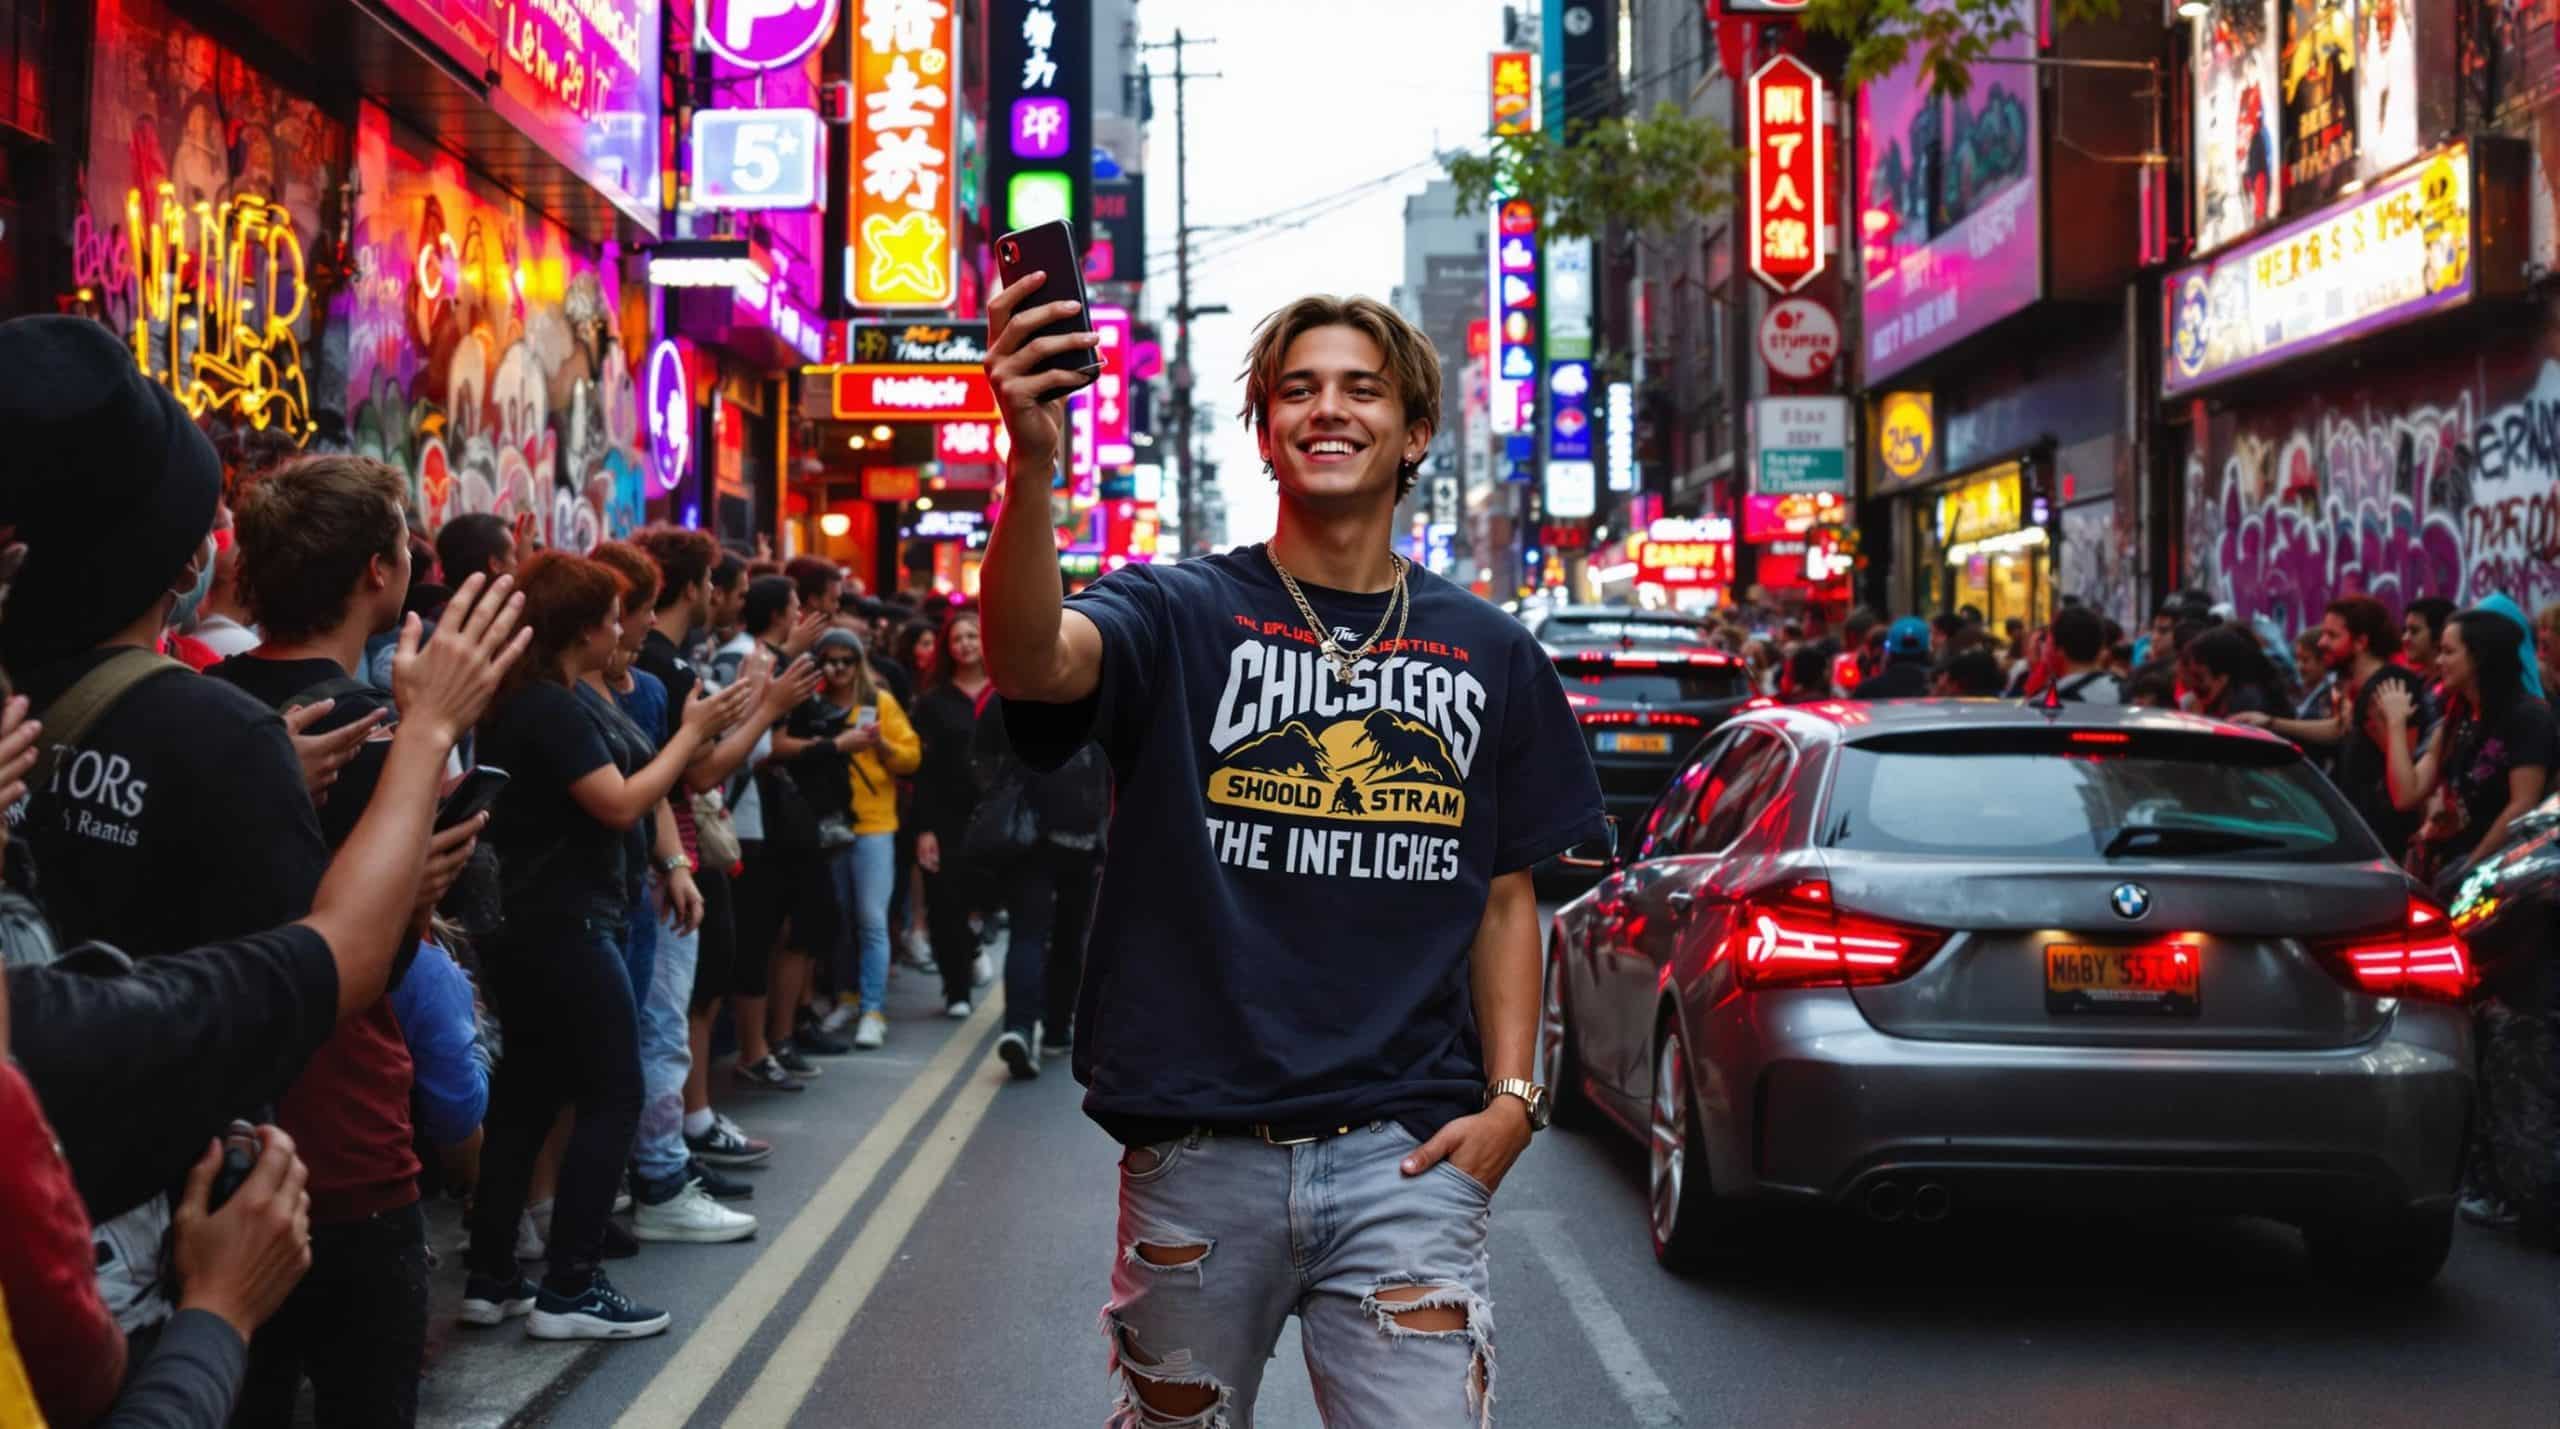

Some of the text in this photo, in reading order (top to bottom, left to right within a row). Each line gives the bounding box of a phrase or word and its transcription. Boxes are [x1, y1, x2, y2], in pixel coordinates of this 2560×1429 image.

[731, 123, 780, 192] 5
[1370, 787, 1462, 819] STRAM
[77, 809, 139, 847] Ramis
[1206, 817, 1273, 871] THE
